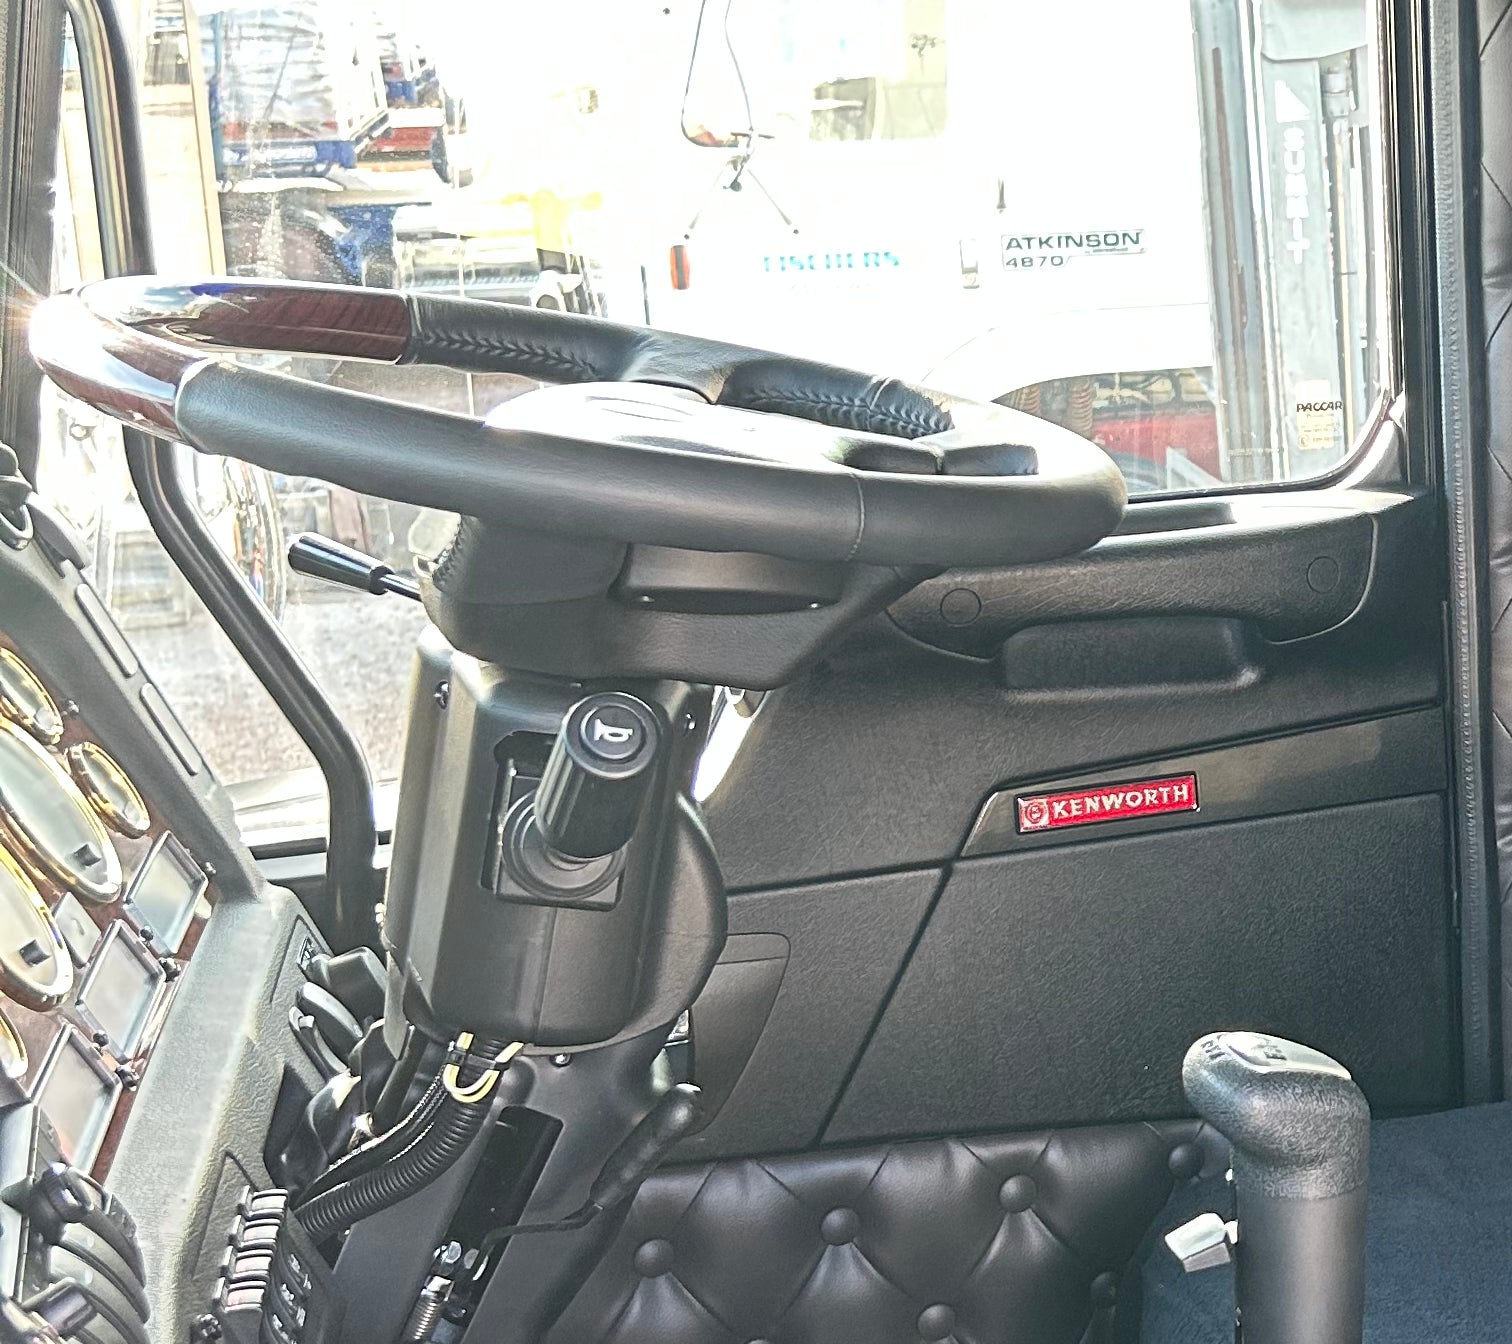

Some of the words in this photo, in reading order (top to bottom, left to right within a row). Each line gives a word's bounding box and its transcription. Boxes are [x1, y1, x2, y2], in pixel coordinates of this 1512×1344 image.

[1006, 232, 1141, 250] ATKINSON
[1006, 255, 1064, 268] 4870
[1296, 401, 1343, 412] PACCAR
[1053, 784, 1189, 819] KENWORTH
